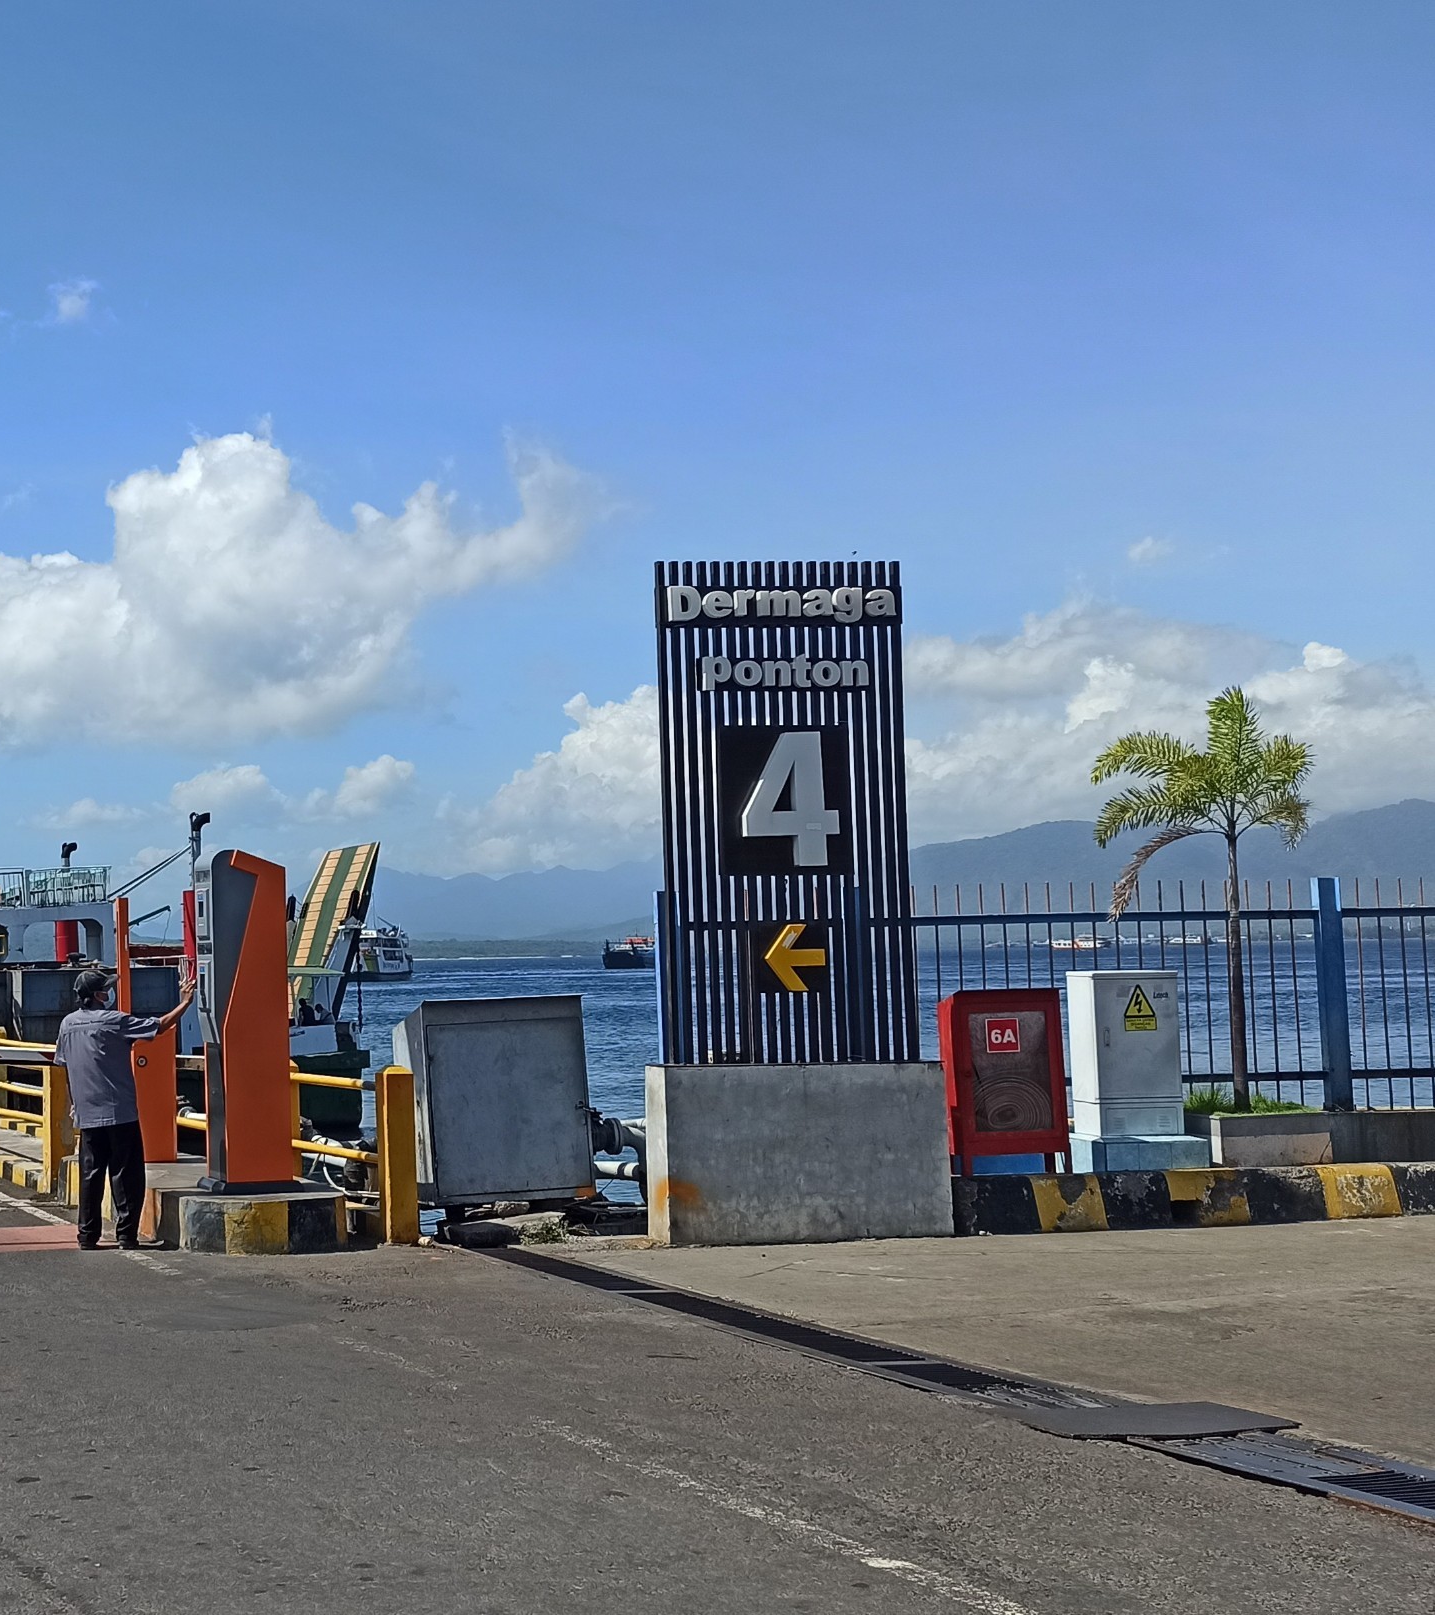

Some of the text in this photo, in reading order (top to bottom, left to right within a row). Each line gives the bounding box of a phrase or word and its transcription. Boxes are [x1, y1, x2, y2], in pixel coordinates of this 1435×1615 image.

[666, 585, 897, 624] Dermaga
[741, 730, 841, 867] 4
[990, 1028, 1017, 1044] 6A
